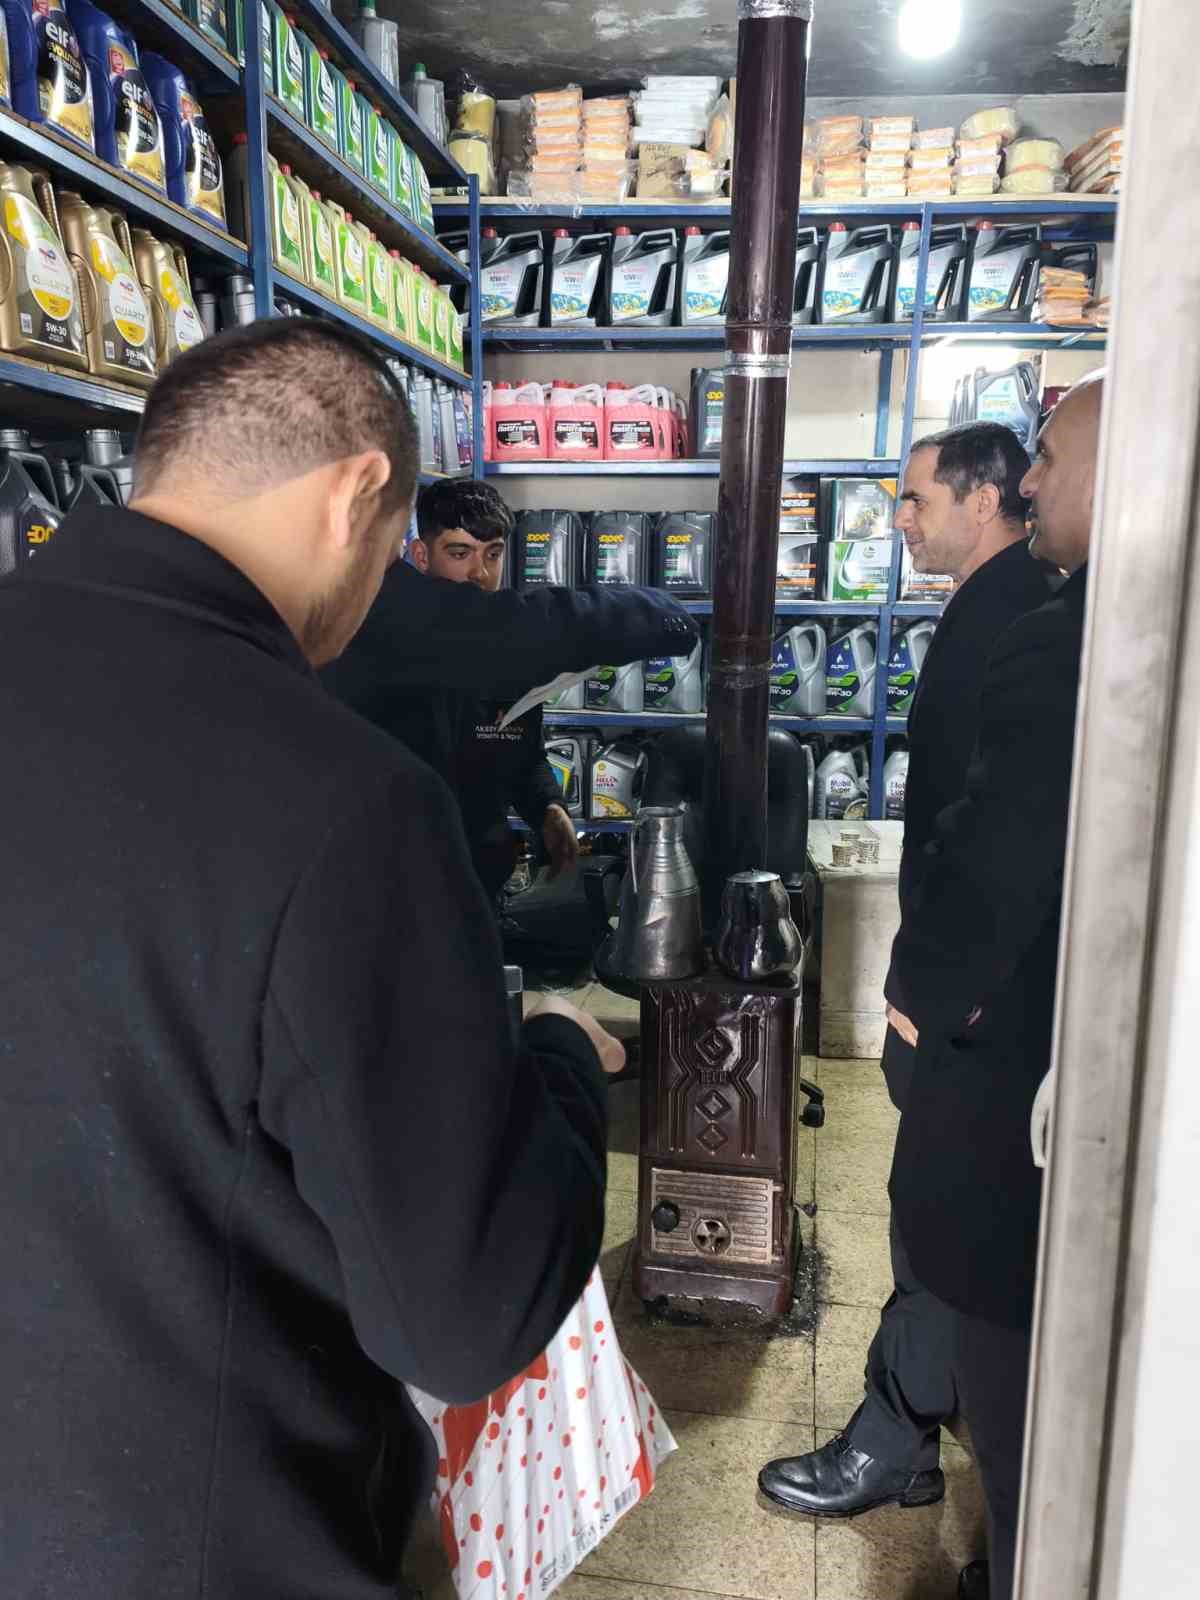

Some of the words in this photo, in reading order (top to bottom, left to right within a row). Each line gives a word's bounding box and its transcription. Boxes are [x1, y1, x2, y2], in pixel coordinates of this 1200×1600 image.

[45, 22, 71, 49] elf
[121, 80, 143, 104] elf
[45, 322, 68, 337] 5W-30
